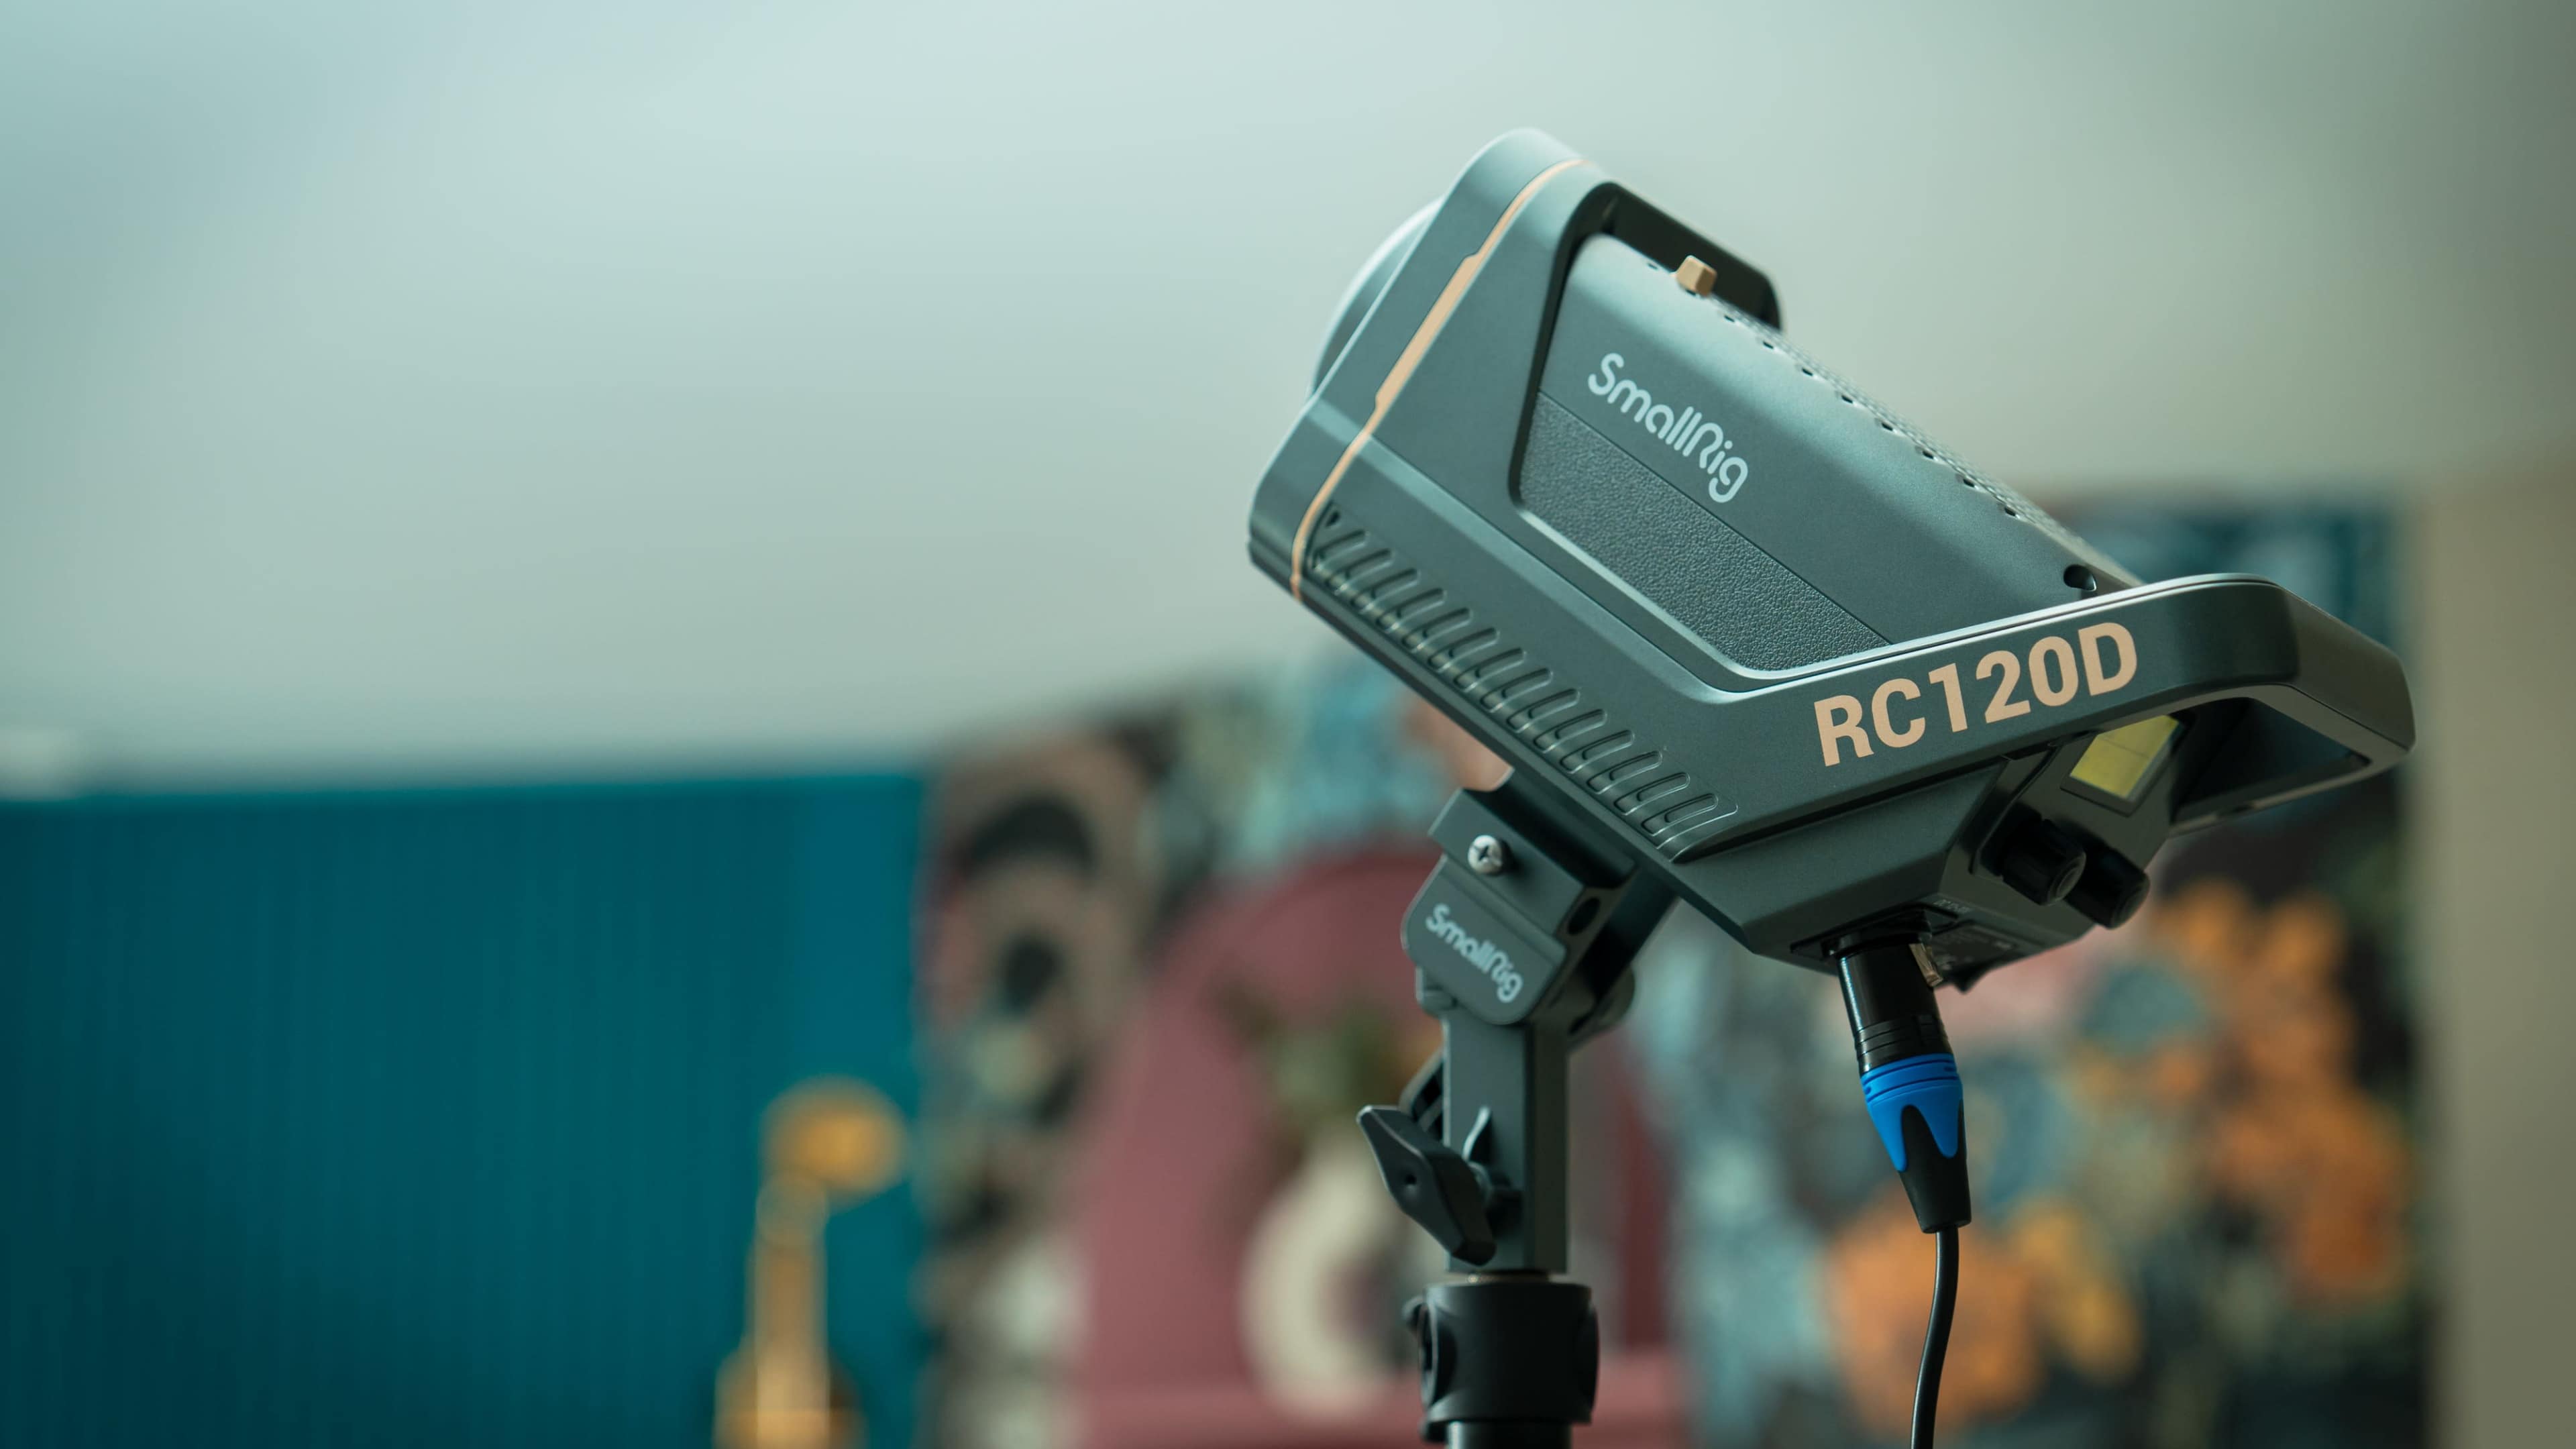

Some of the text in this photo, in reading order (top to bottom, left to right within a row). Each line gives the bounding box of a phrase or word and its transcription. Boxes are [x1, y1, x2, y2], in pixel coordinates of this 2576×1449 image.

[1588, 353, 1748, 502] SmallRig
[1814, 622, 2137, 767] RC120D
[1426, 904, 1522, 1002] SmallRig
